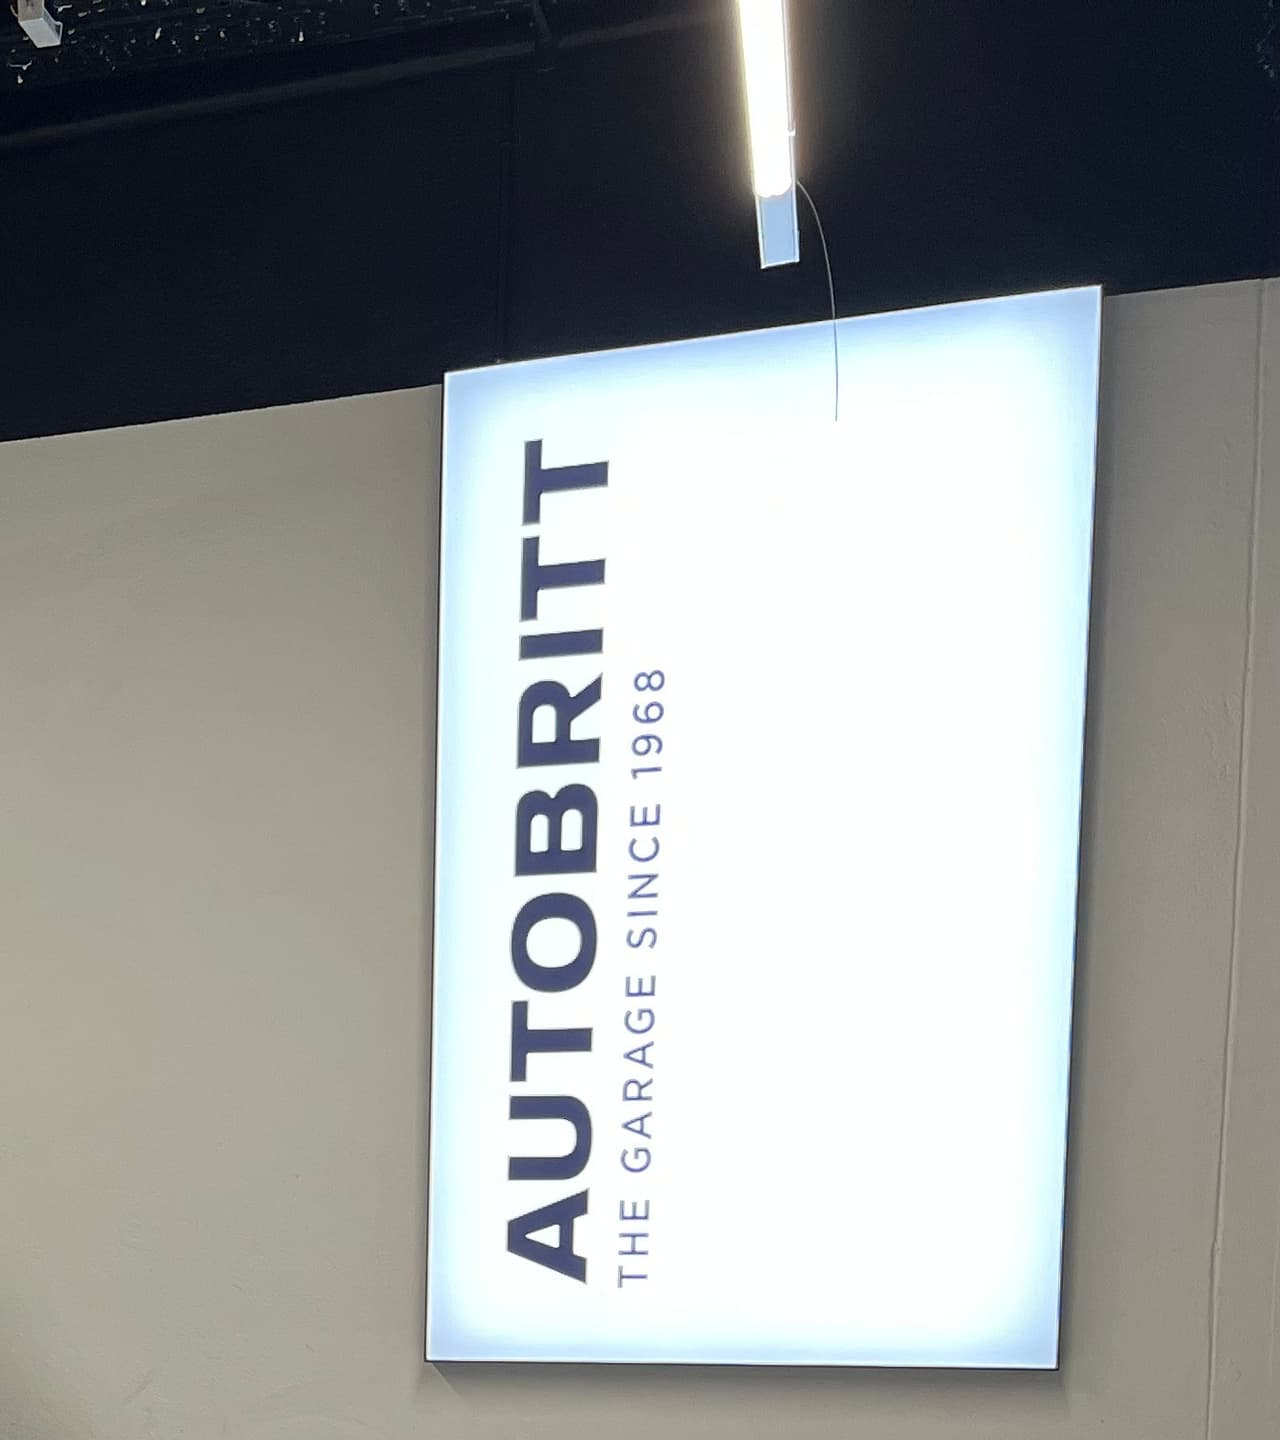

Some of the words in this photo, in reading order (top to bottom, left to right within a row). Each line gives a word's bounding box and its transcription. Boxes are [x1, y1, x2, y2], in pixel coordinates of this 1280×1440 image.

[630, 669, 666, 780] 1968
[506, 438, 610, 1285] AUTOBRITT
[625, 803, 662, 950] SINCE
[620, 975, 657, 1173] GARAGE
[617, 1199, 651, 1288] THE
